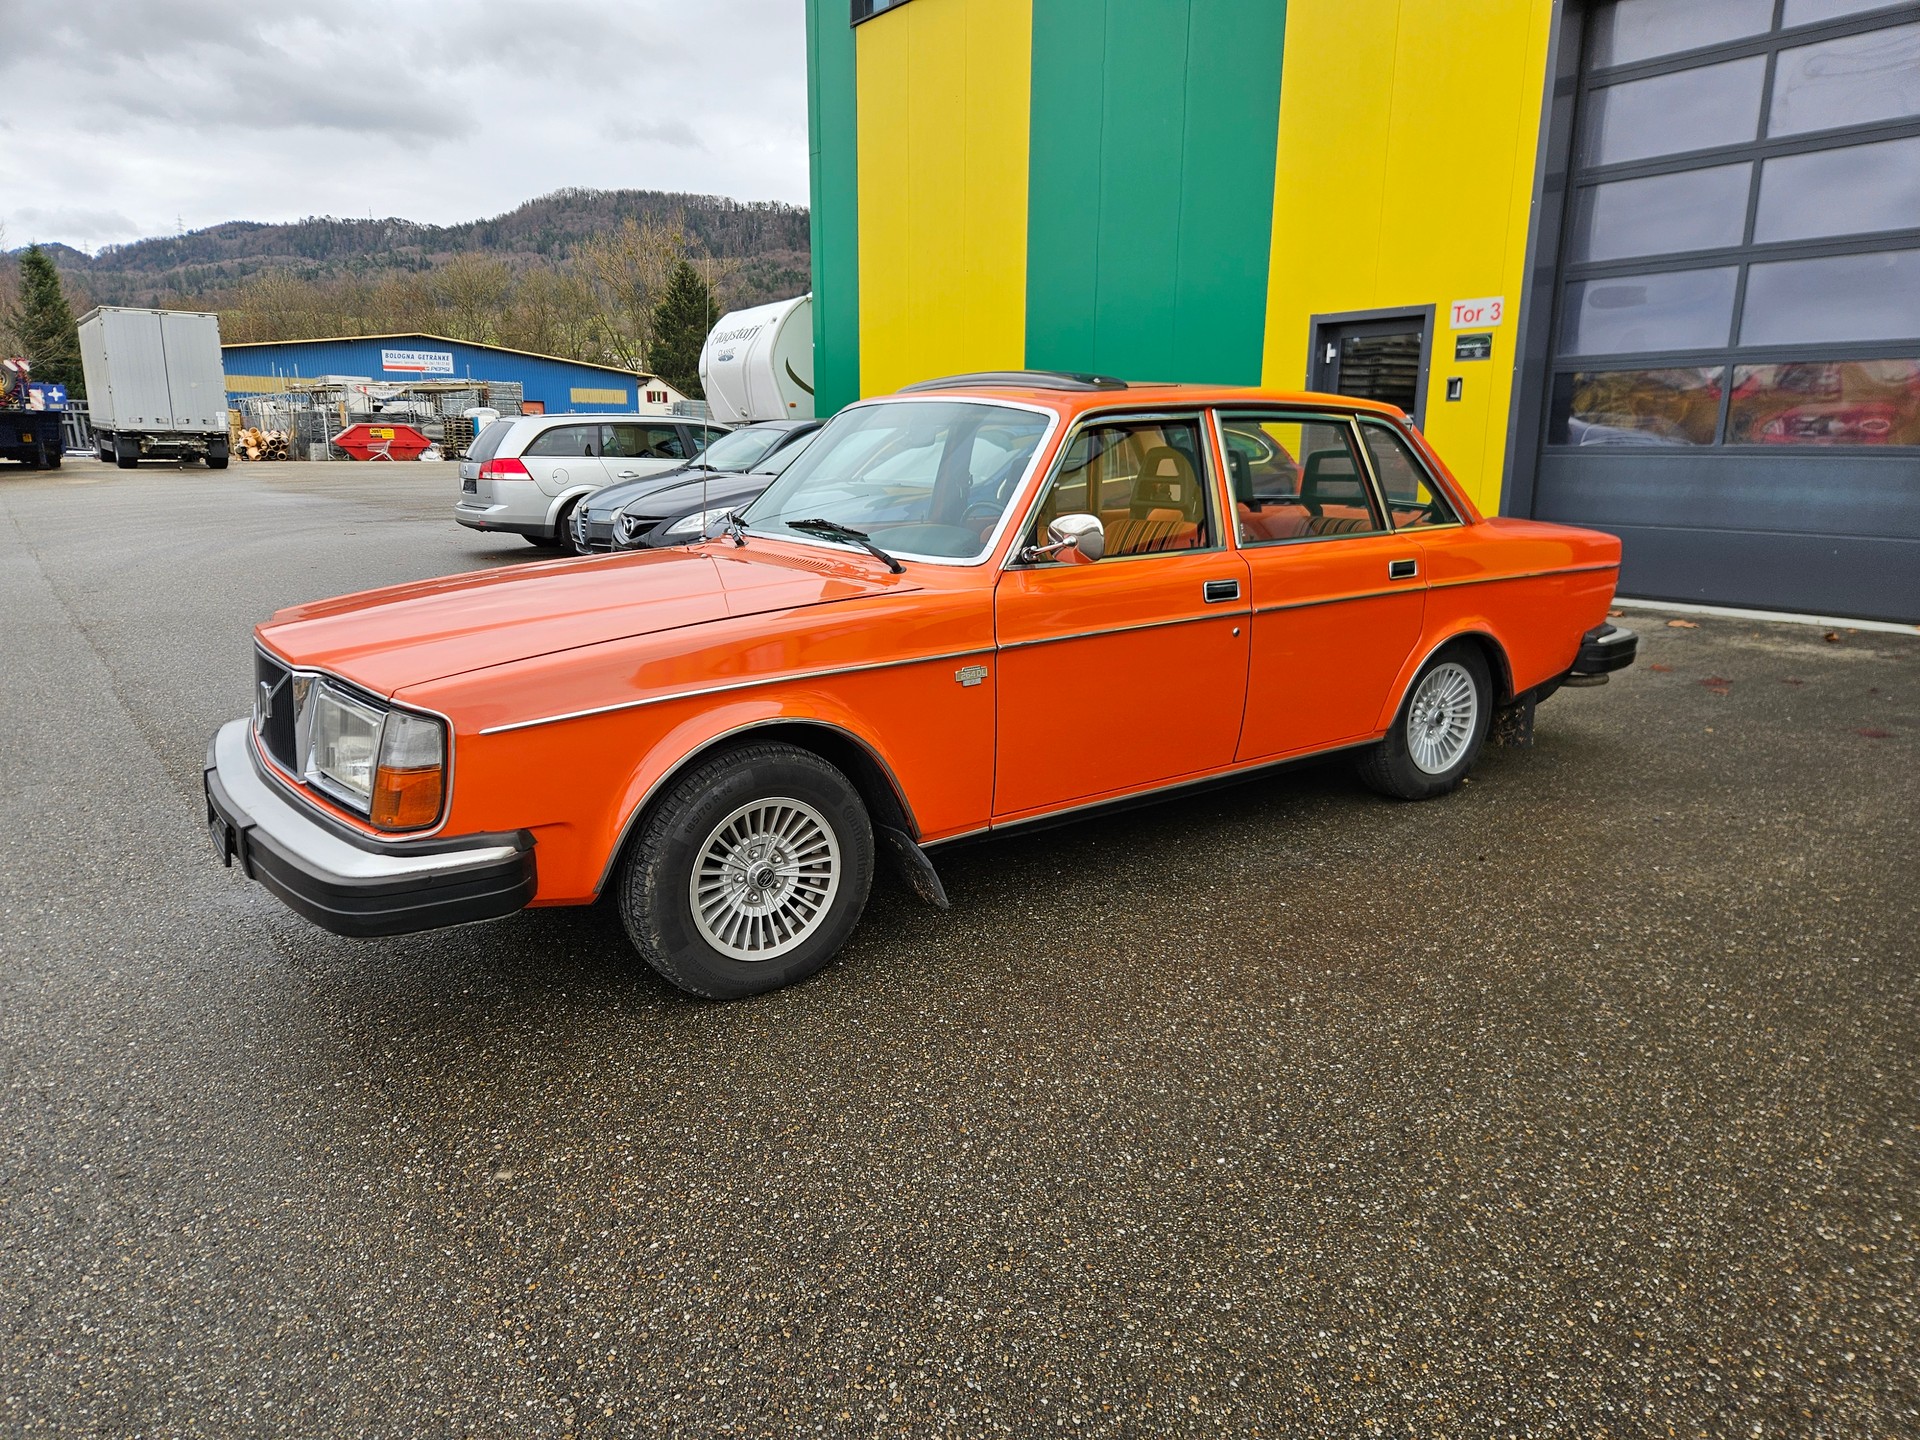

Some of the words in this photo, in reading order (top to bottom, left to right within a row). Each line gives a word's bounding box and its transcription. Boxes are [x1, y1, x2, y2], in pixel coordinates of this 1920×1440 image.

[1453, 304, 1484, 323] Tor
[1490, 302, 1501, 321] 3
[711, 325, 763, 346] Flagstaff
[384, 352, 415, 360] BOLOGNA
